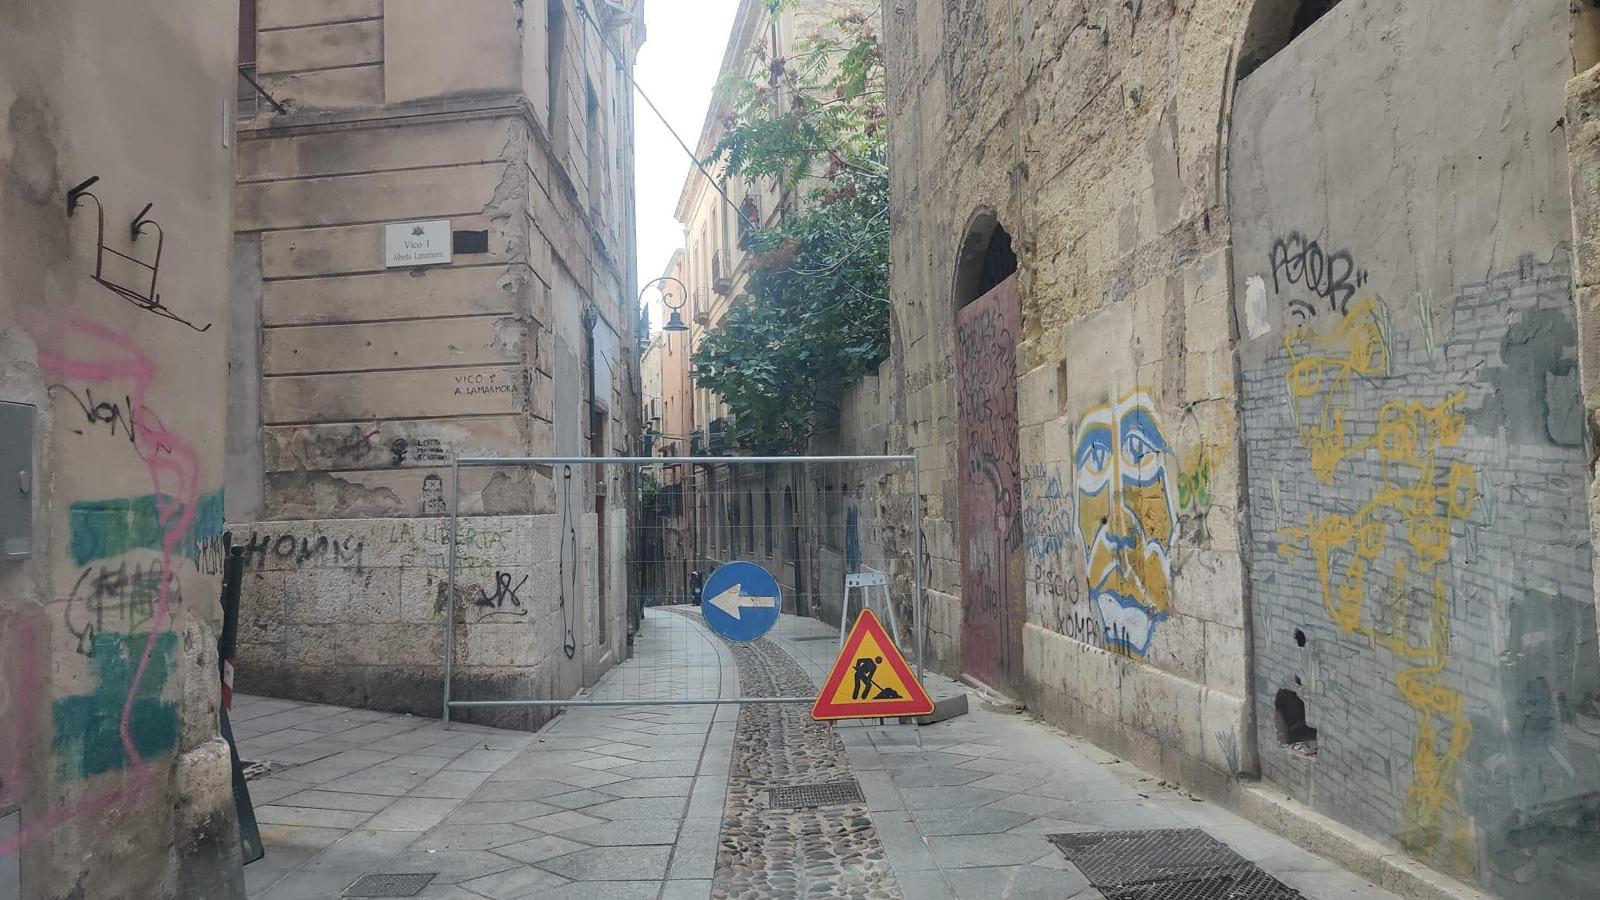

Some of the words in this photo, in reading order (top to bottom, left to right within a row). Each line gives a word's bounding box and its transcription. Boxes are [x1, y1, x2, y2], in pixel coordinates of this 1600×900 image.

[404, 241, 422, 250] Vico
[454, 374, 483, 384] VICO
[466, 384, 519, 395] LAMARMORA
